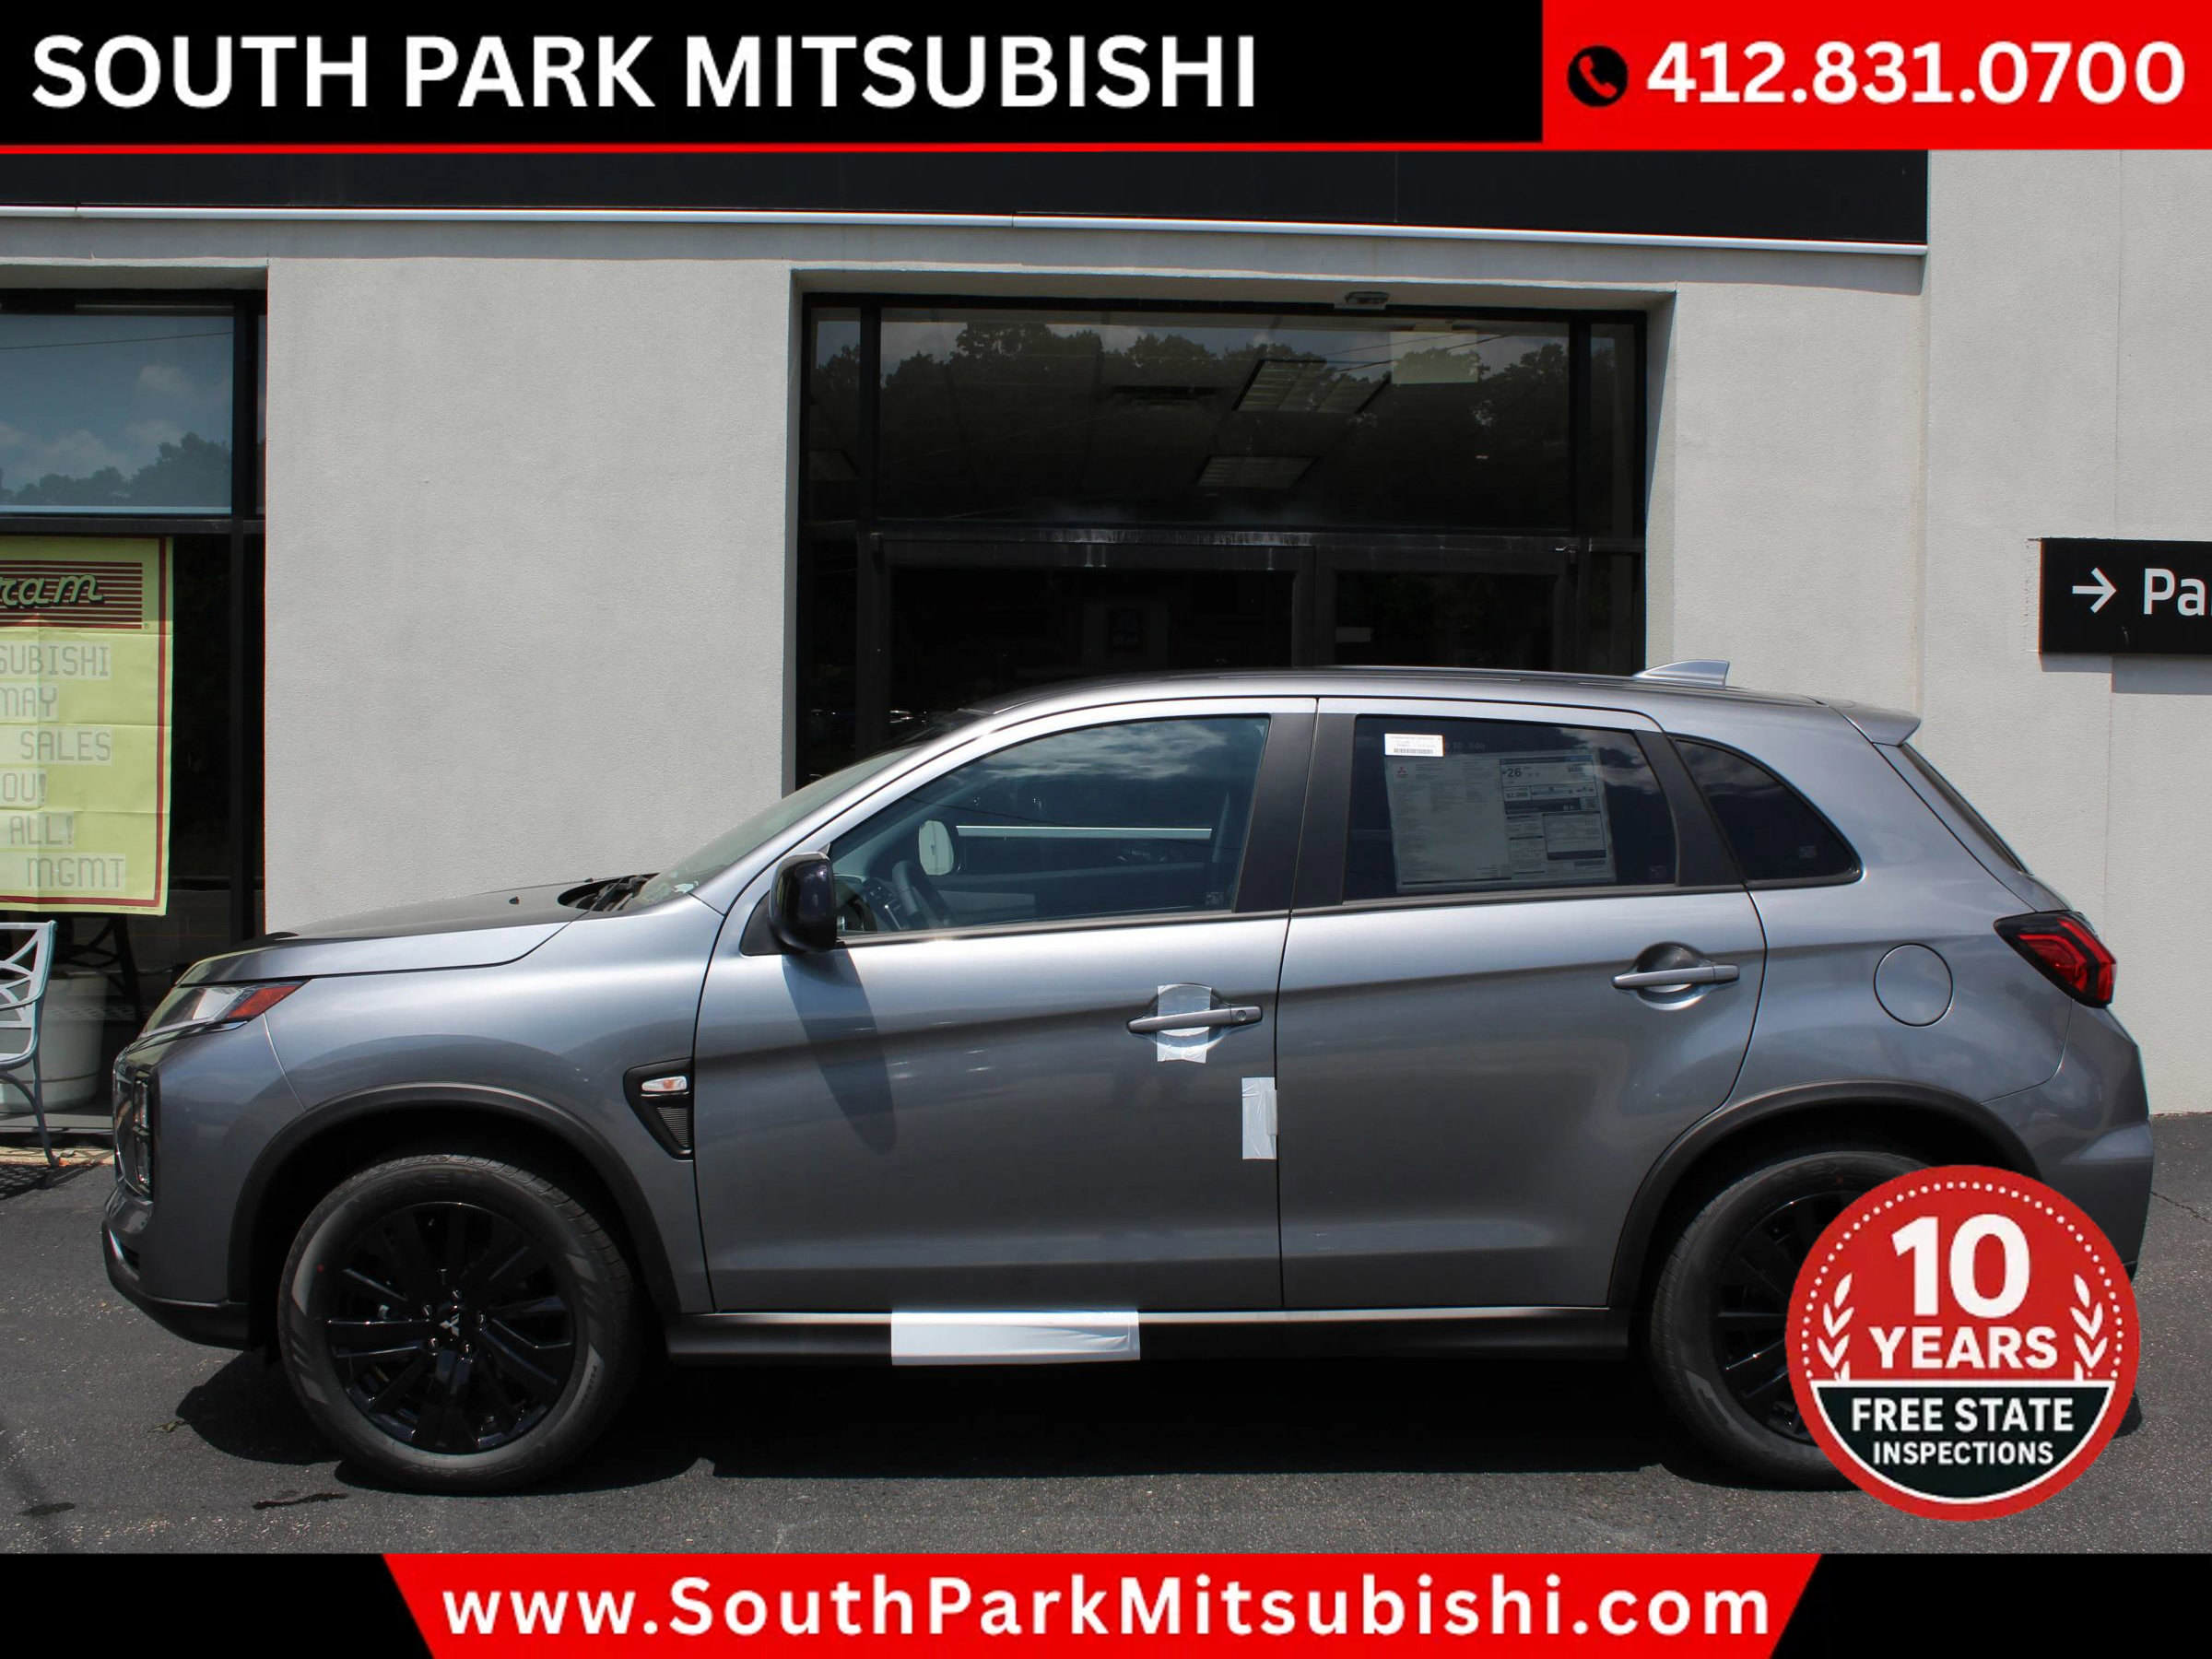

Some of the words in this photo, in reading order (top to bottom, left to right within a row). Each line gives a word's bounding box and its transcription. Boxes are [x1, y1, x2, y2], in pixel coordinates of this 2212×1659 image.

[20, 730, 112, 761] SALES
[10, 815, 74, 846] ALL!
[26, 856, 125, 888] MGMT
